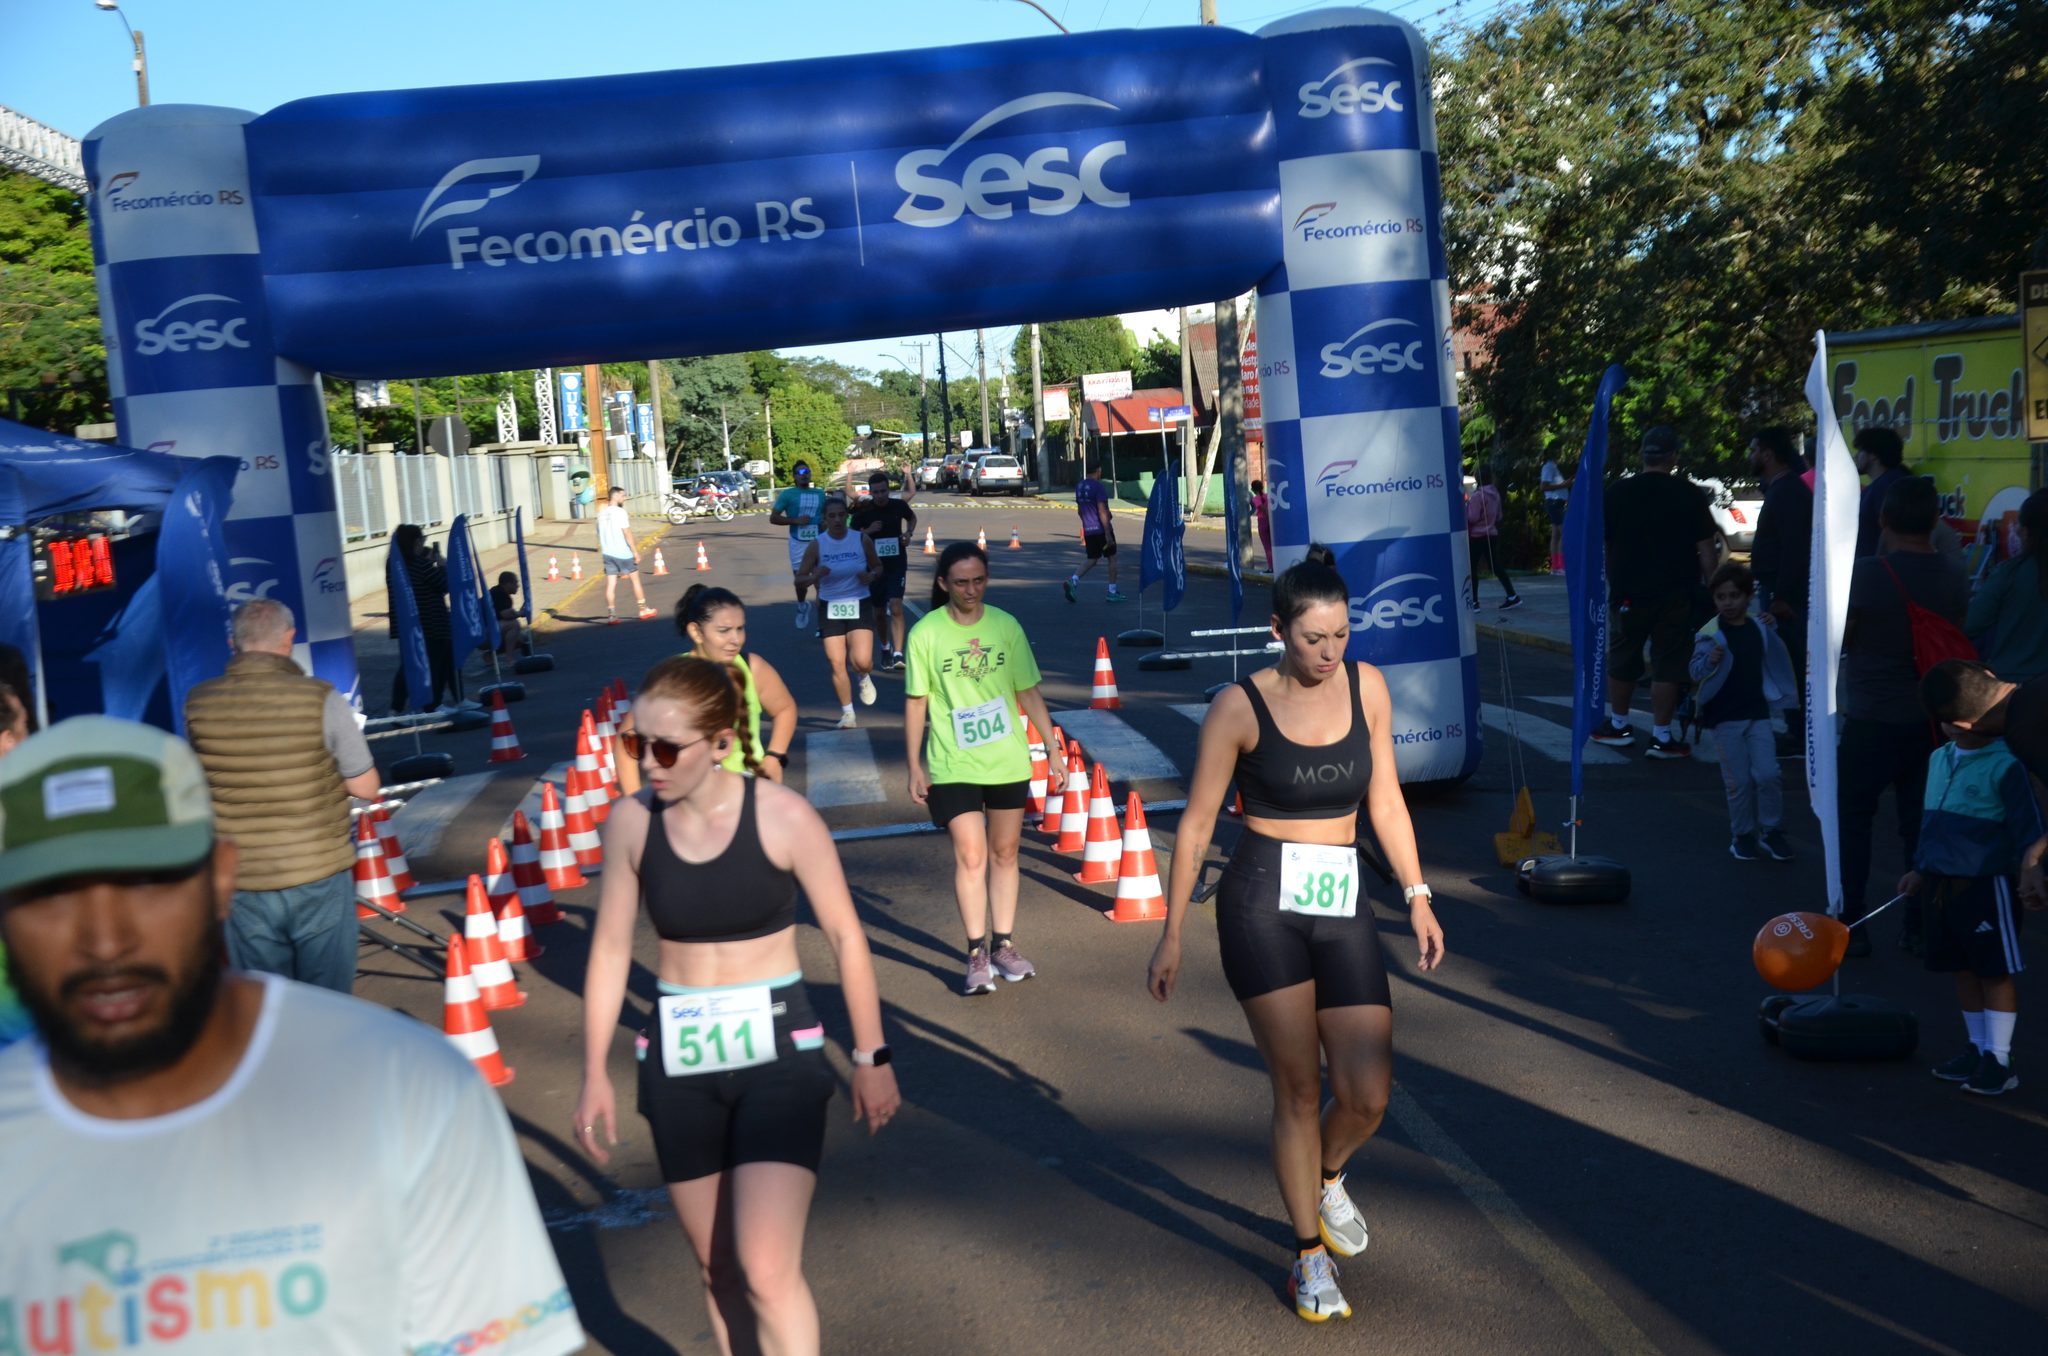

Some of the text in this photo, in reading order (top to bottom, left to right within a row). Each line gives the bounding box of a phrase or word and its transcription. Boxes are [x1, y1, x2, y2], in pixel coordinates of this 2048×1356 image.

[112, 189, 244, 212] Fecomércio RS
[447, 196, 825, 270] Fecomércio RS
[1303, 217, 1424, 242] Fecomércio RS
[1274, 360, 1290, 376] RS
[1834, 360, 1916, 443] Food
[255, 456, 280, 470] RS
[1326, 473, 1444, 498] Fecomércio RS
[879, 544, 897, 555] 499
[832, 604, 856, 617] 393
[963, 712, 1005, 743] 504
[1391, 723, 1463, 746] mércio RS
[1292, 761, 1354, 784] MOV
[1294, 871, 1349, 909] 381
[1785, 912, 1815, 940] CRESO
[679, 1018, 755, 1067] 511
